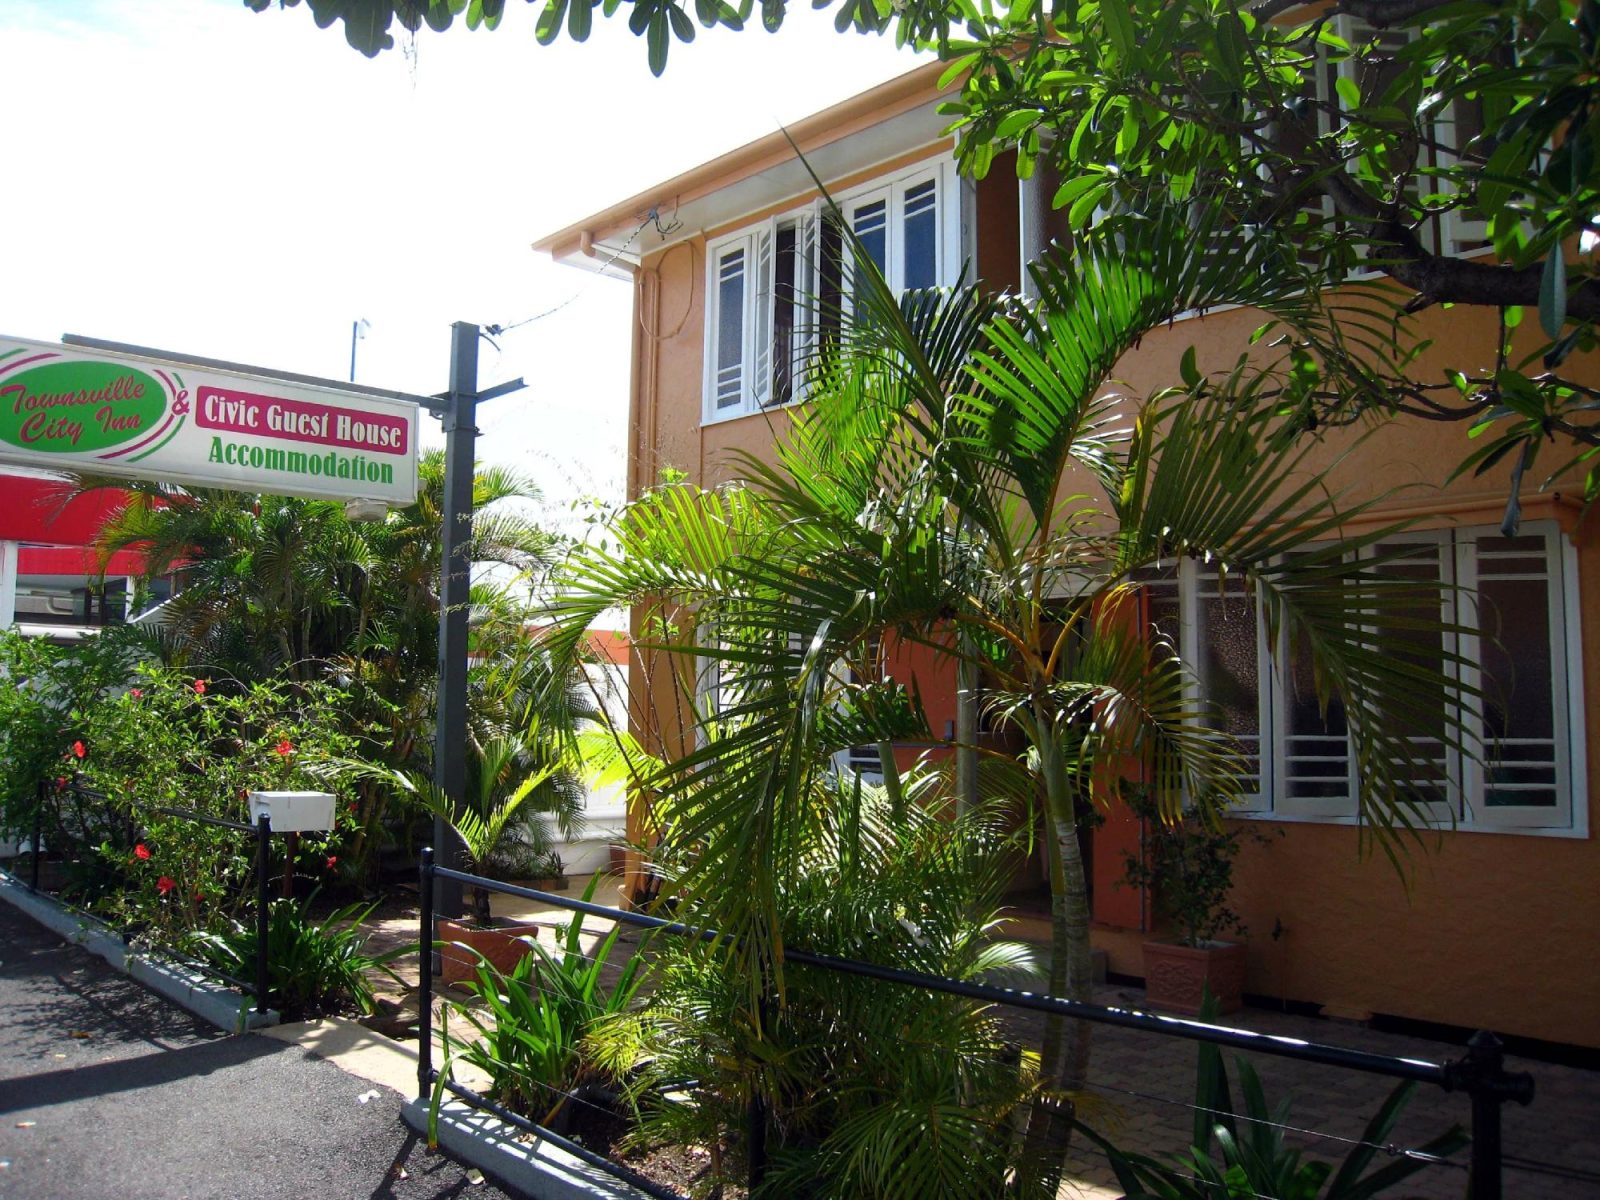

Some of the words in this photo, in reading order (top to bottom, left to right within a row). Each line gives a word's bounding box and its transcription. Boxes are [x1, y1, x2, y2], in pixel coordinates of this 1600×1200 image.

[0, 375, 146, 414] Townsville
[171, 390, 190, 415] &
[20, 412, 83, 445] City
[95, 406, 142, 433] Inn
[204, 394, 260, 428] Civic
[266, 404, 329, 438] Guest
[336, 414, 401, 448] House
[208, 436, 393, 484] Accommodation
